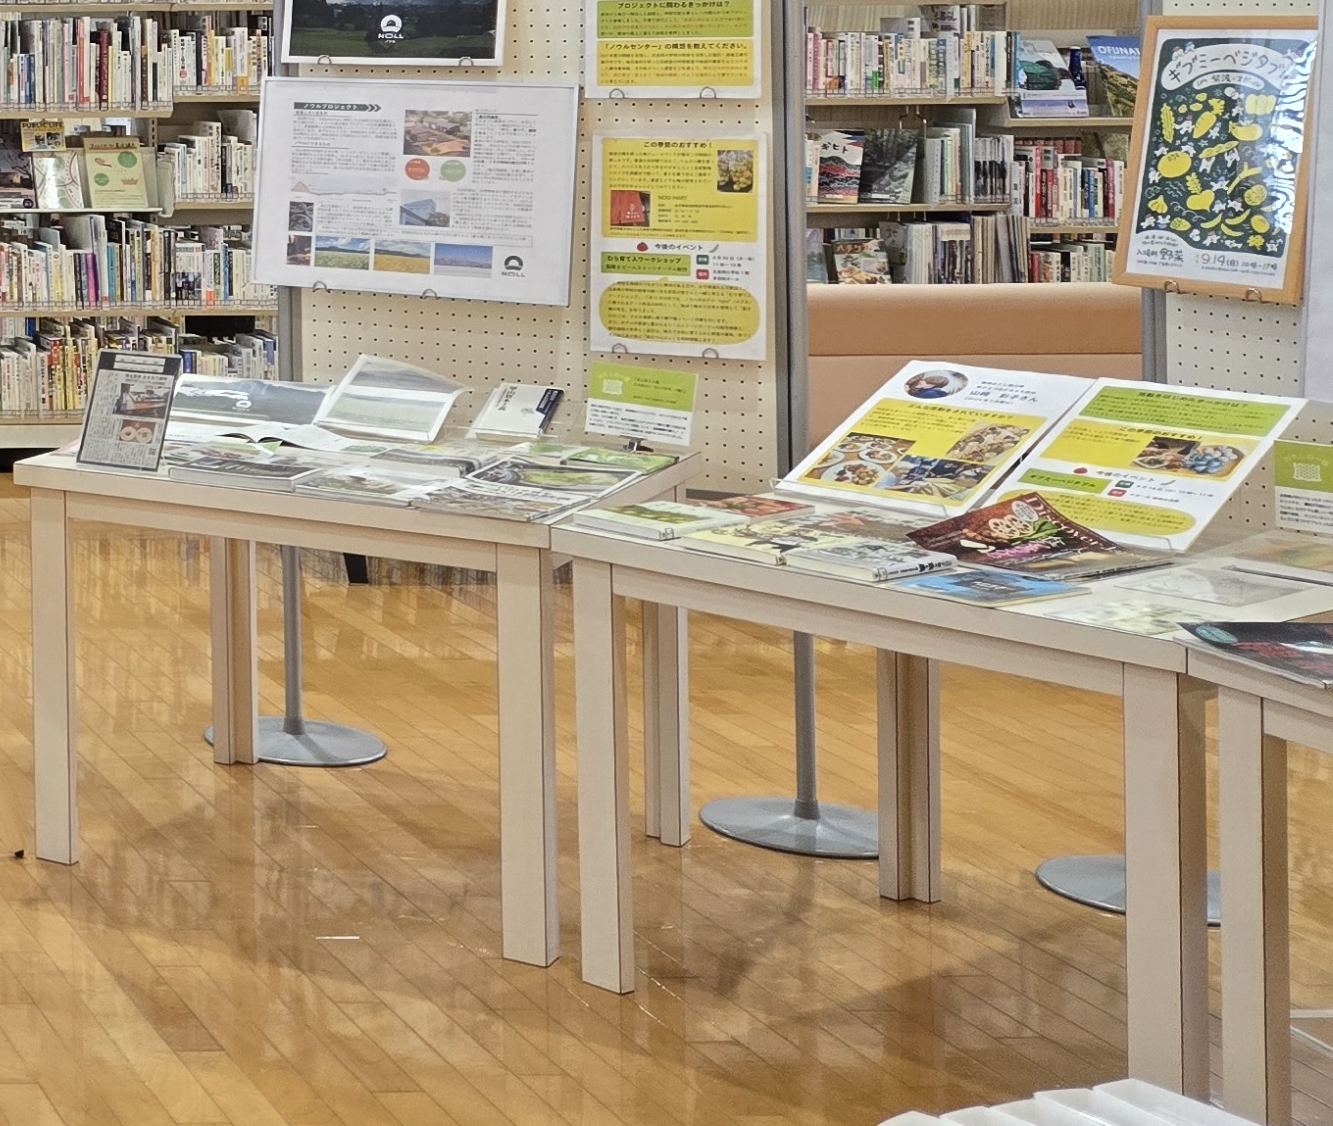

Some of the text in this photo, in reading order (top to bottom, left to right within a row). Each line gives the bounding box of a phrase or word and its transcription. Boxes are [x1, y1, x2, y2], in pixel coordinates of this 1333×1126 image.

[1168, 49, 1287, 83] ギブミーベジタブ
[654, 243, 704, 252] 今後のイベント
